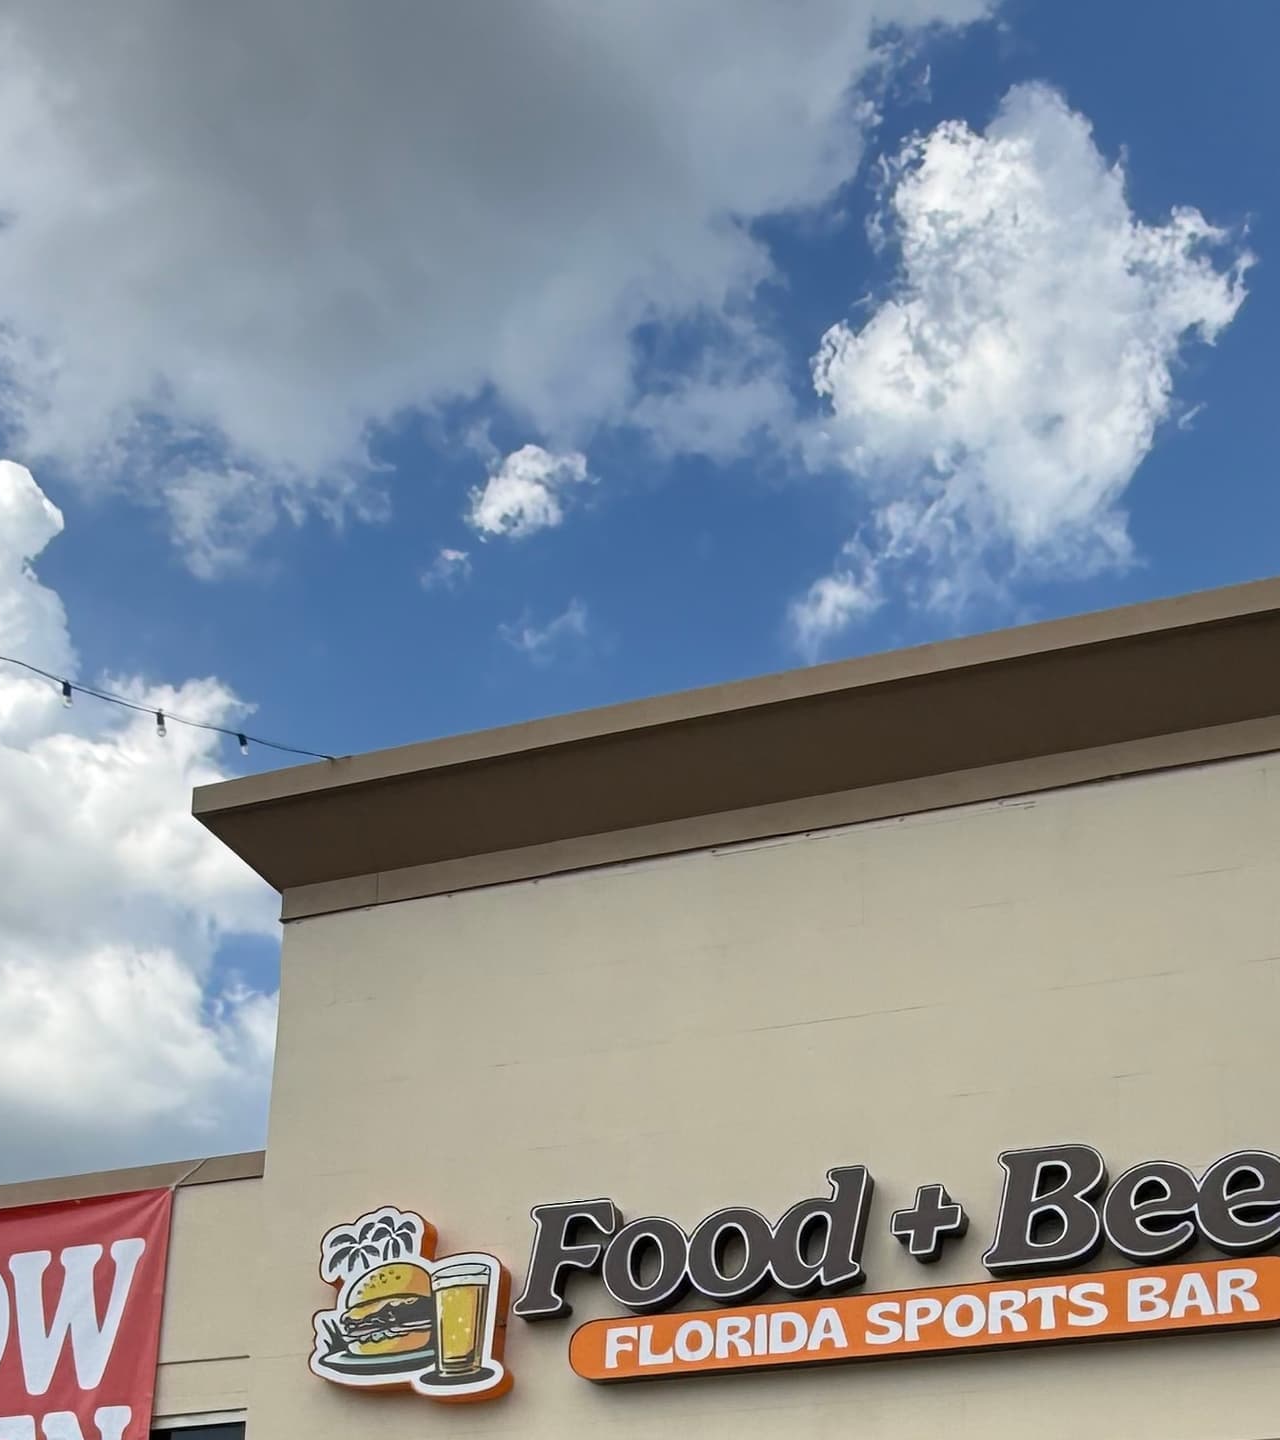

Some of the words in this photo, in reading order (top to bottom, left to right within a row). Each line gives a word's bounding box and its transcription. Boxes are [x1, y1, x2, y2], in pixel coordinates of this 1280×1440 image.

[513, 1164, 874, 1321] Food
[889, 1183, 970, 1264] +
[604, 1307, 849, 1370] FLORIDA
[865, 1282, 1109, 1346] SPORTS
[1126, 1267, 1261, 1324] BAR
